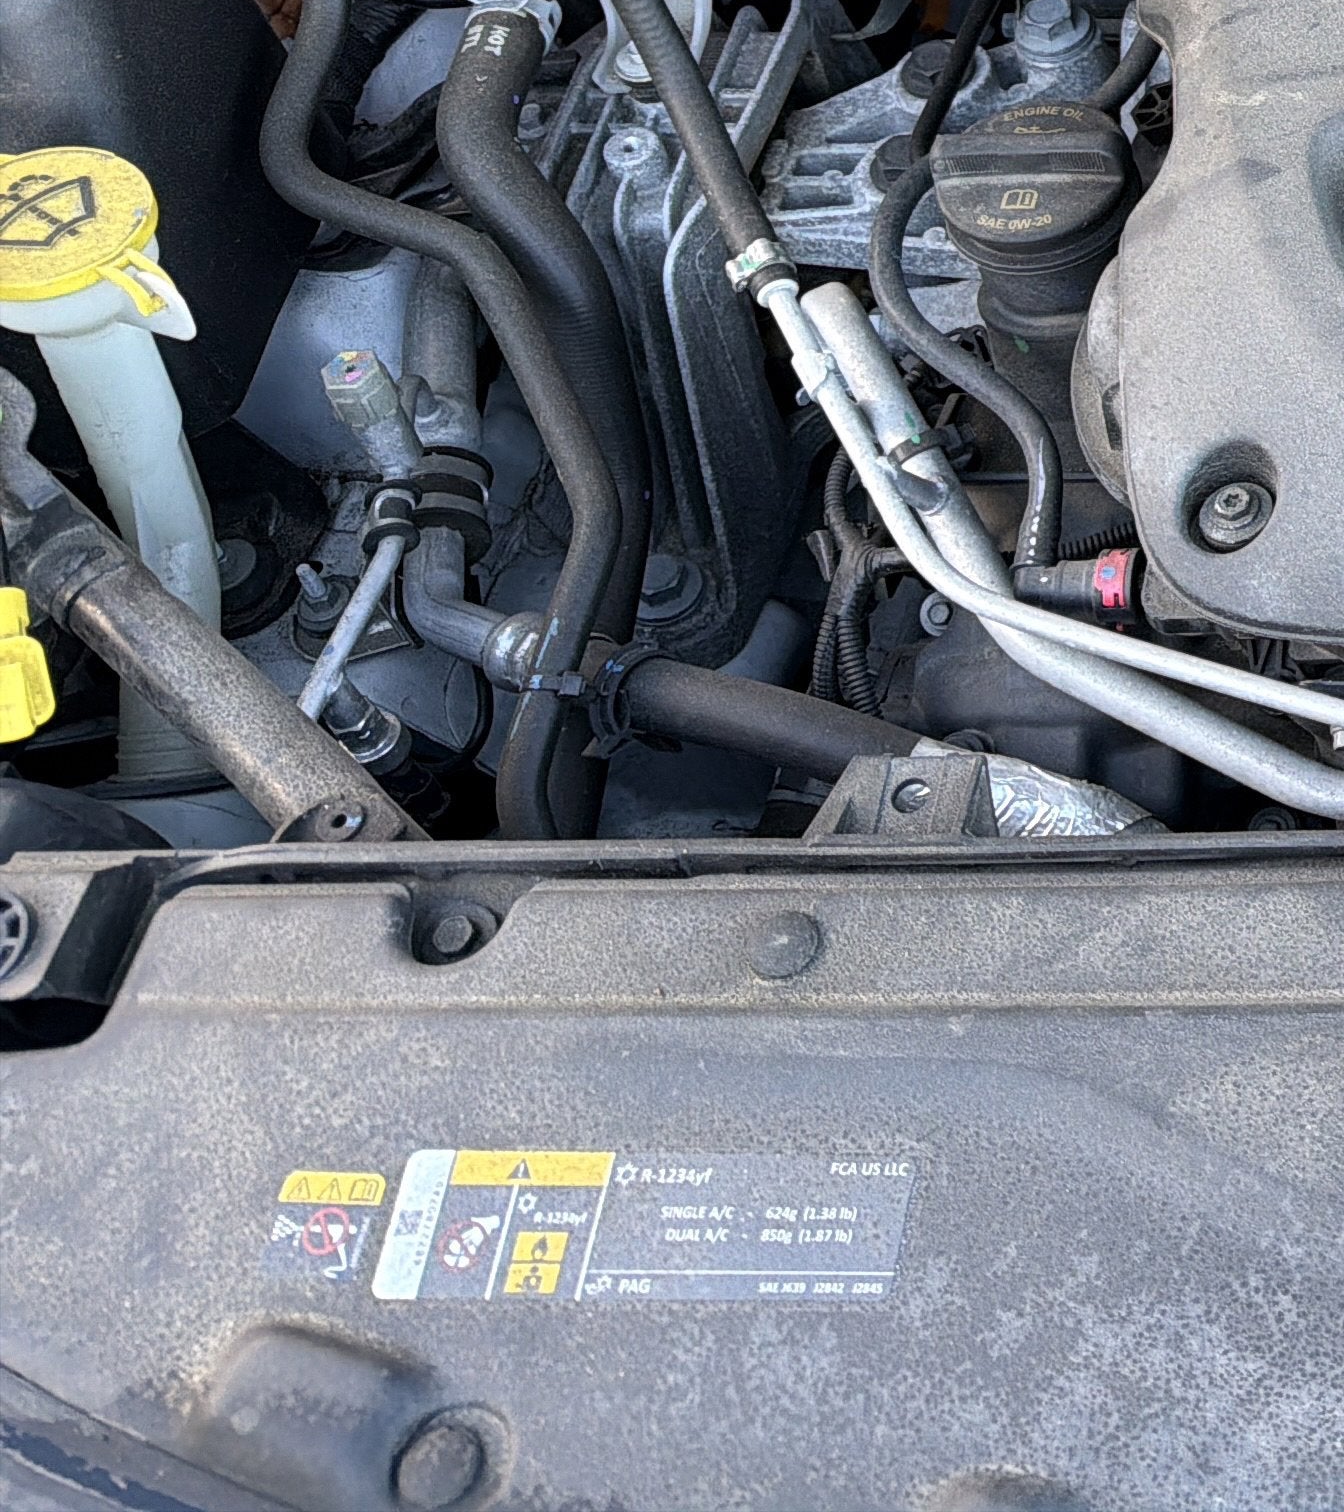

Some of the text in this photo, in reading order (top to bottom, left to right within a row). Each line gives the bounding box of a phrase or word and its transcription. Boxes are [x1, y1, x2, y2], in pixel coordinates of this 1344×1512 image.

[1003, 106, 1085, 122] ENGINE OIL
[976, 214, 1053, 230] SAE 0W-20
[829, 1162, 857, 1176] FCA
[861, 1162, 881, 1176] US
[883, 1162, 909, 1176] LLC
[660, 1206, 706, 1220] SINGLE
[708, 1205, 736, 1221] A/C
[765, 1206, 798, 1222] 624g
[803, 1206, 837, 1222] (1.38
[839, 1206, 858, 1222] lb)
[664, 1228, 700, 1242] DUAL
[703, 1227, 731, 1244] A/C
[760, 1228, 793, 1244] 850g
[798, 1229, 833, 1244] (1.87
[835, 1229, 853, 1244] lb)
[618, 1278, 652, 1294] PAG
